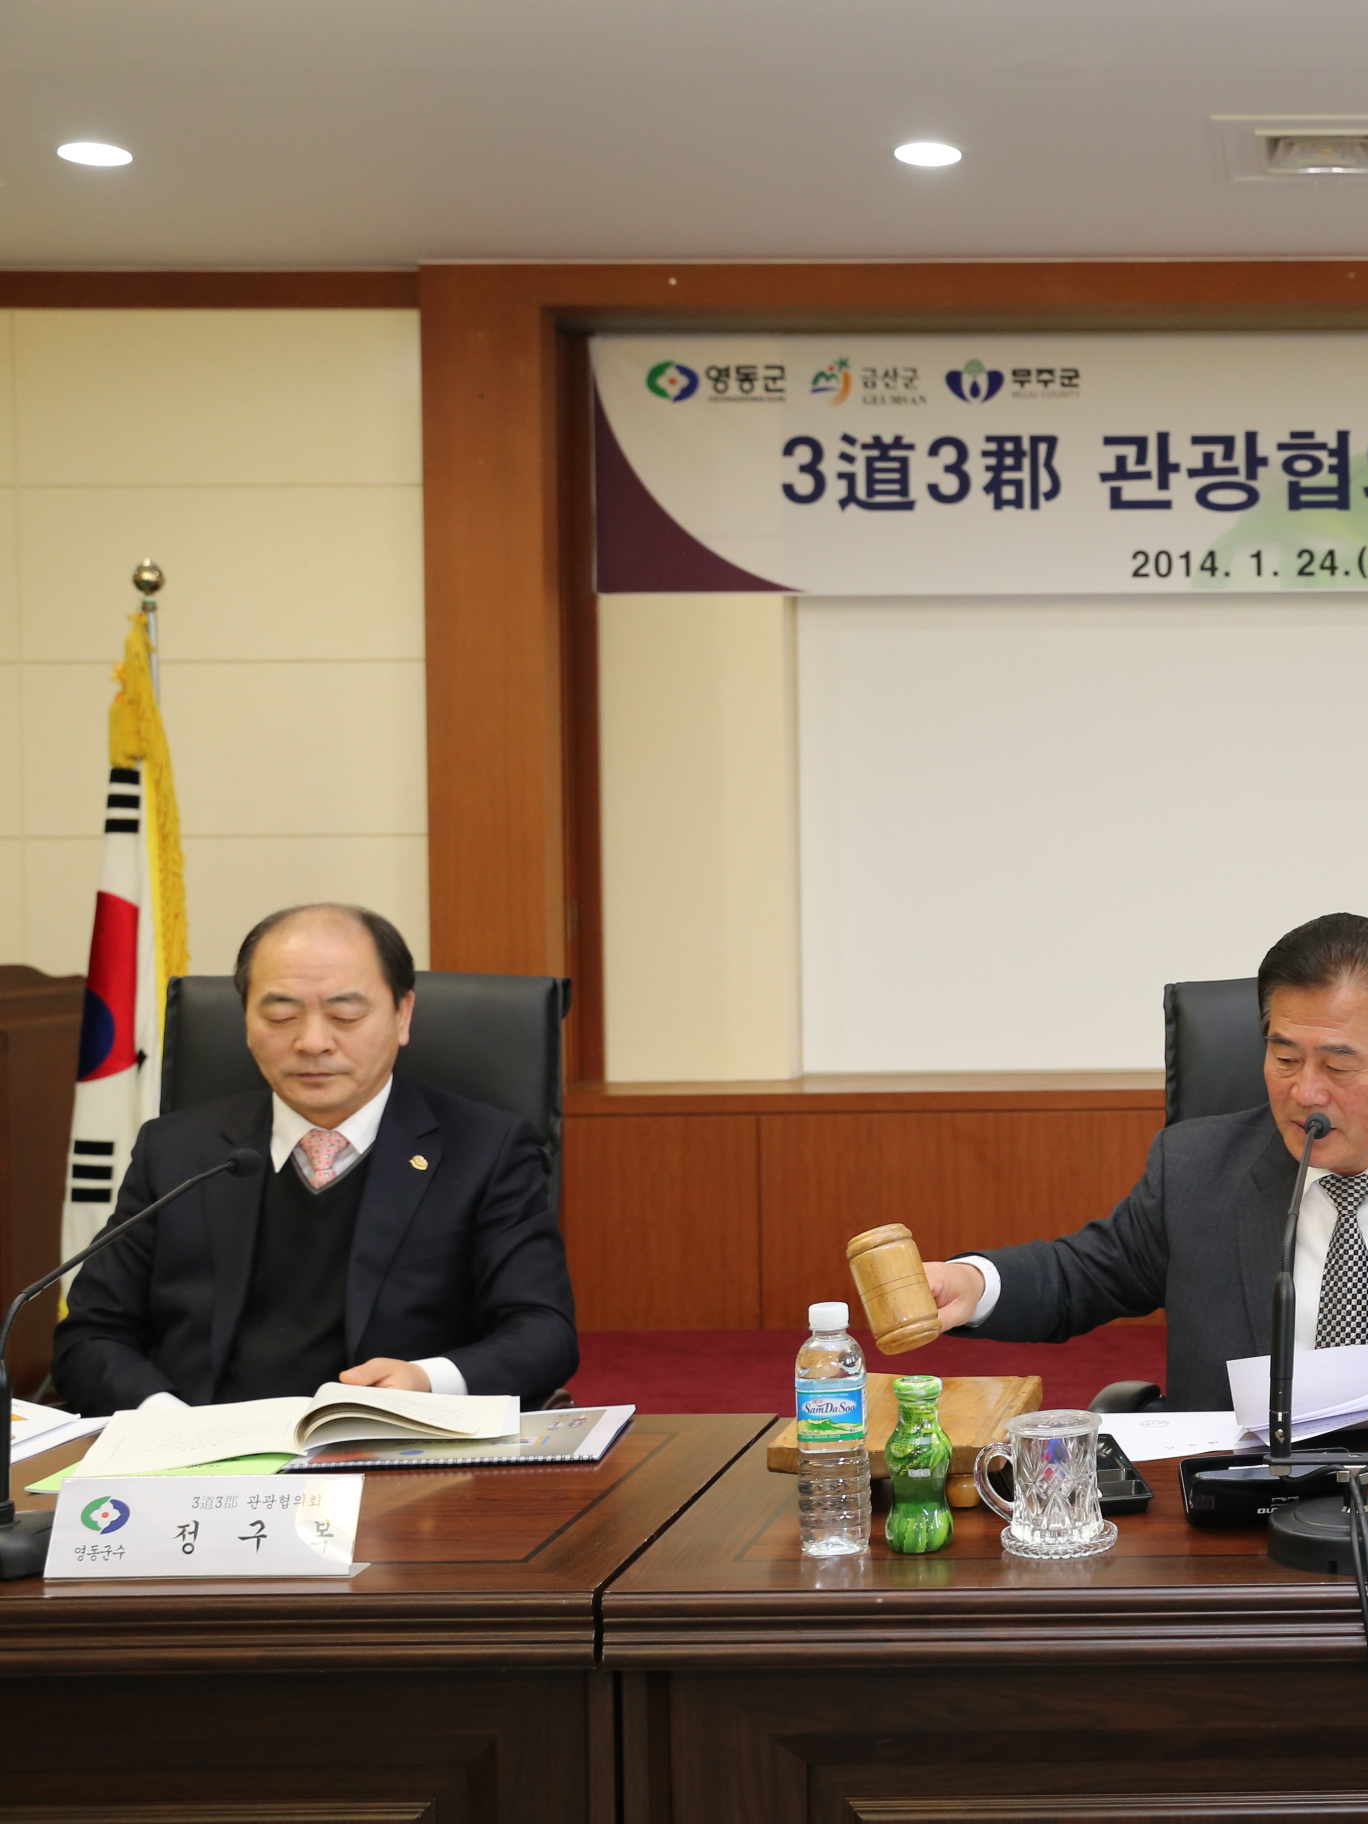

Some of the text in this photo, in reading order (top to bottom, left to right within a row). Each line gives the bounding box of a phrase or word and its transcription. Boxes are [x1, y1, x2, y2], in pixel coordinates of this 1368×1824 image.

[706, 365, 786, 394] 영동군
[861, 367, 919, 391] 금산군
[1011, 368, 1081, 389] 무주군
[780, 432, 1062, 513] 3道3郡
[1131, 549, 1231, 578] 2014.
[1249, 549, 1280, 577] 1.
[191, 1493, 322, 1510] 3道3郡 관광협의회
[170, 1519, 201, 1556] 정
[237, 1518, 268, 1554] 구
[74, 1544, 126, 1562] 영동군수
